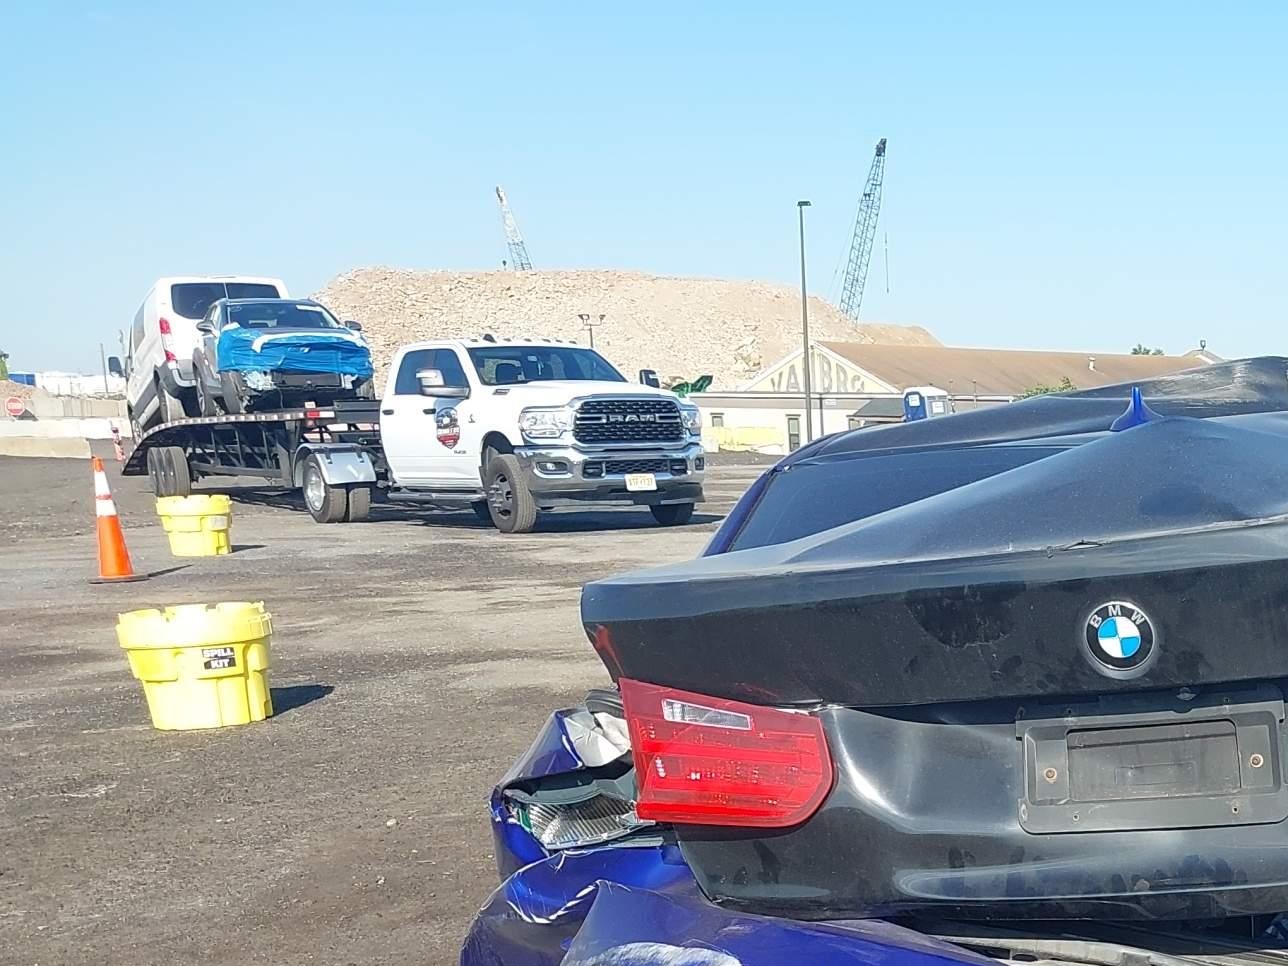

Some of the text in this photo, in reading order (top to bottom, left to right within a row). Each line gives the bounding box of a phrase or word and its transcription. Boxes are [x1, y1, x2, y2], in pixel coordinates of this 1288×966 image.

[609, 414, 655, 422] RAM
[1089, 604, 1145, 629] BMW
[202, 648, 234, 658] SPILL
[210, 659, 230, 669] KIT
